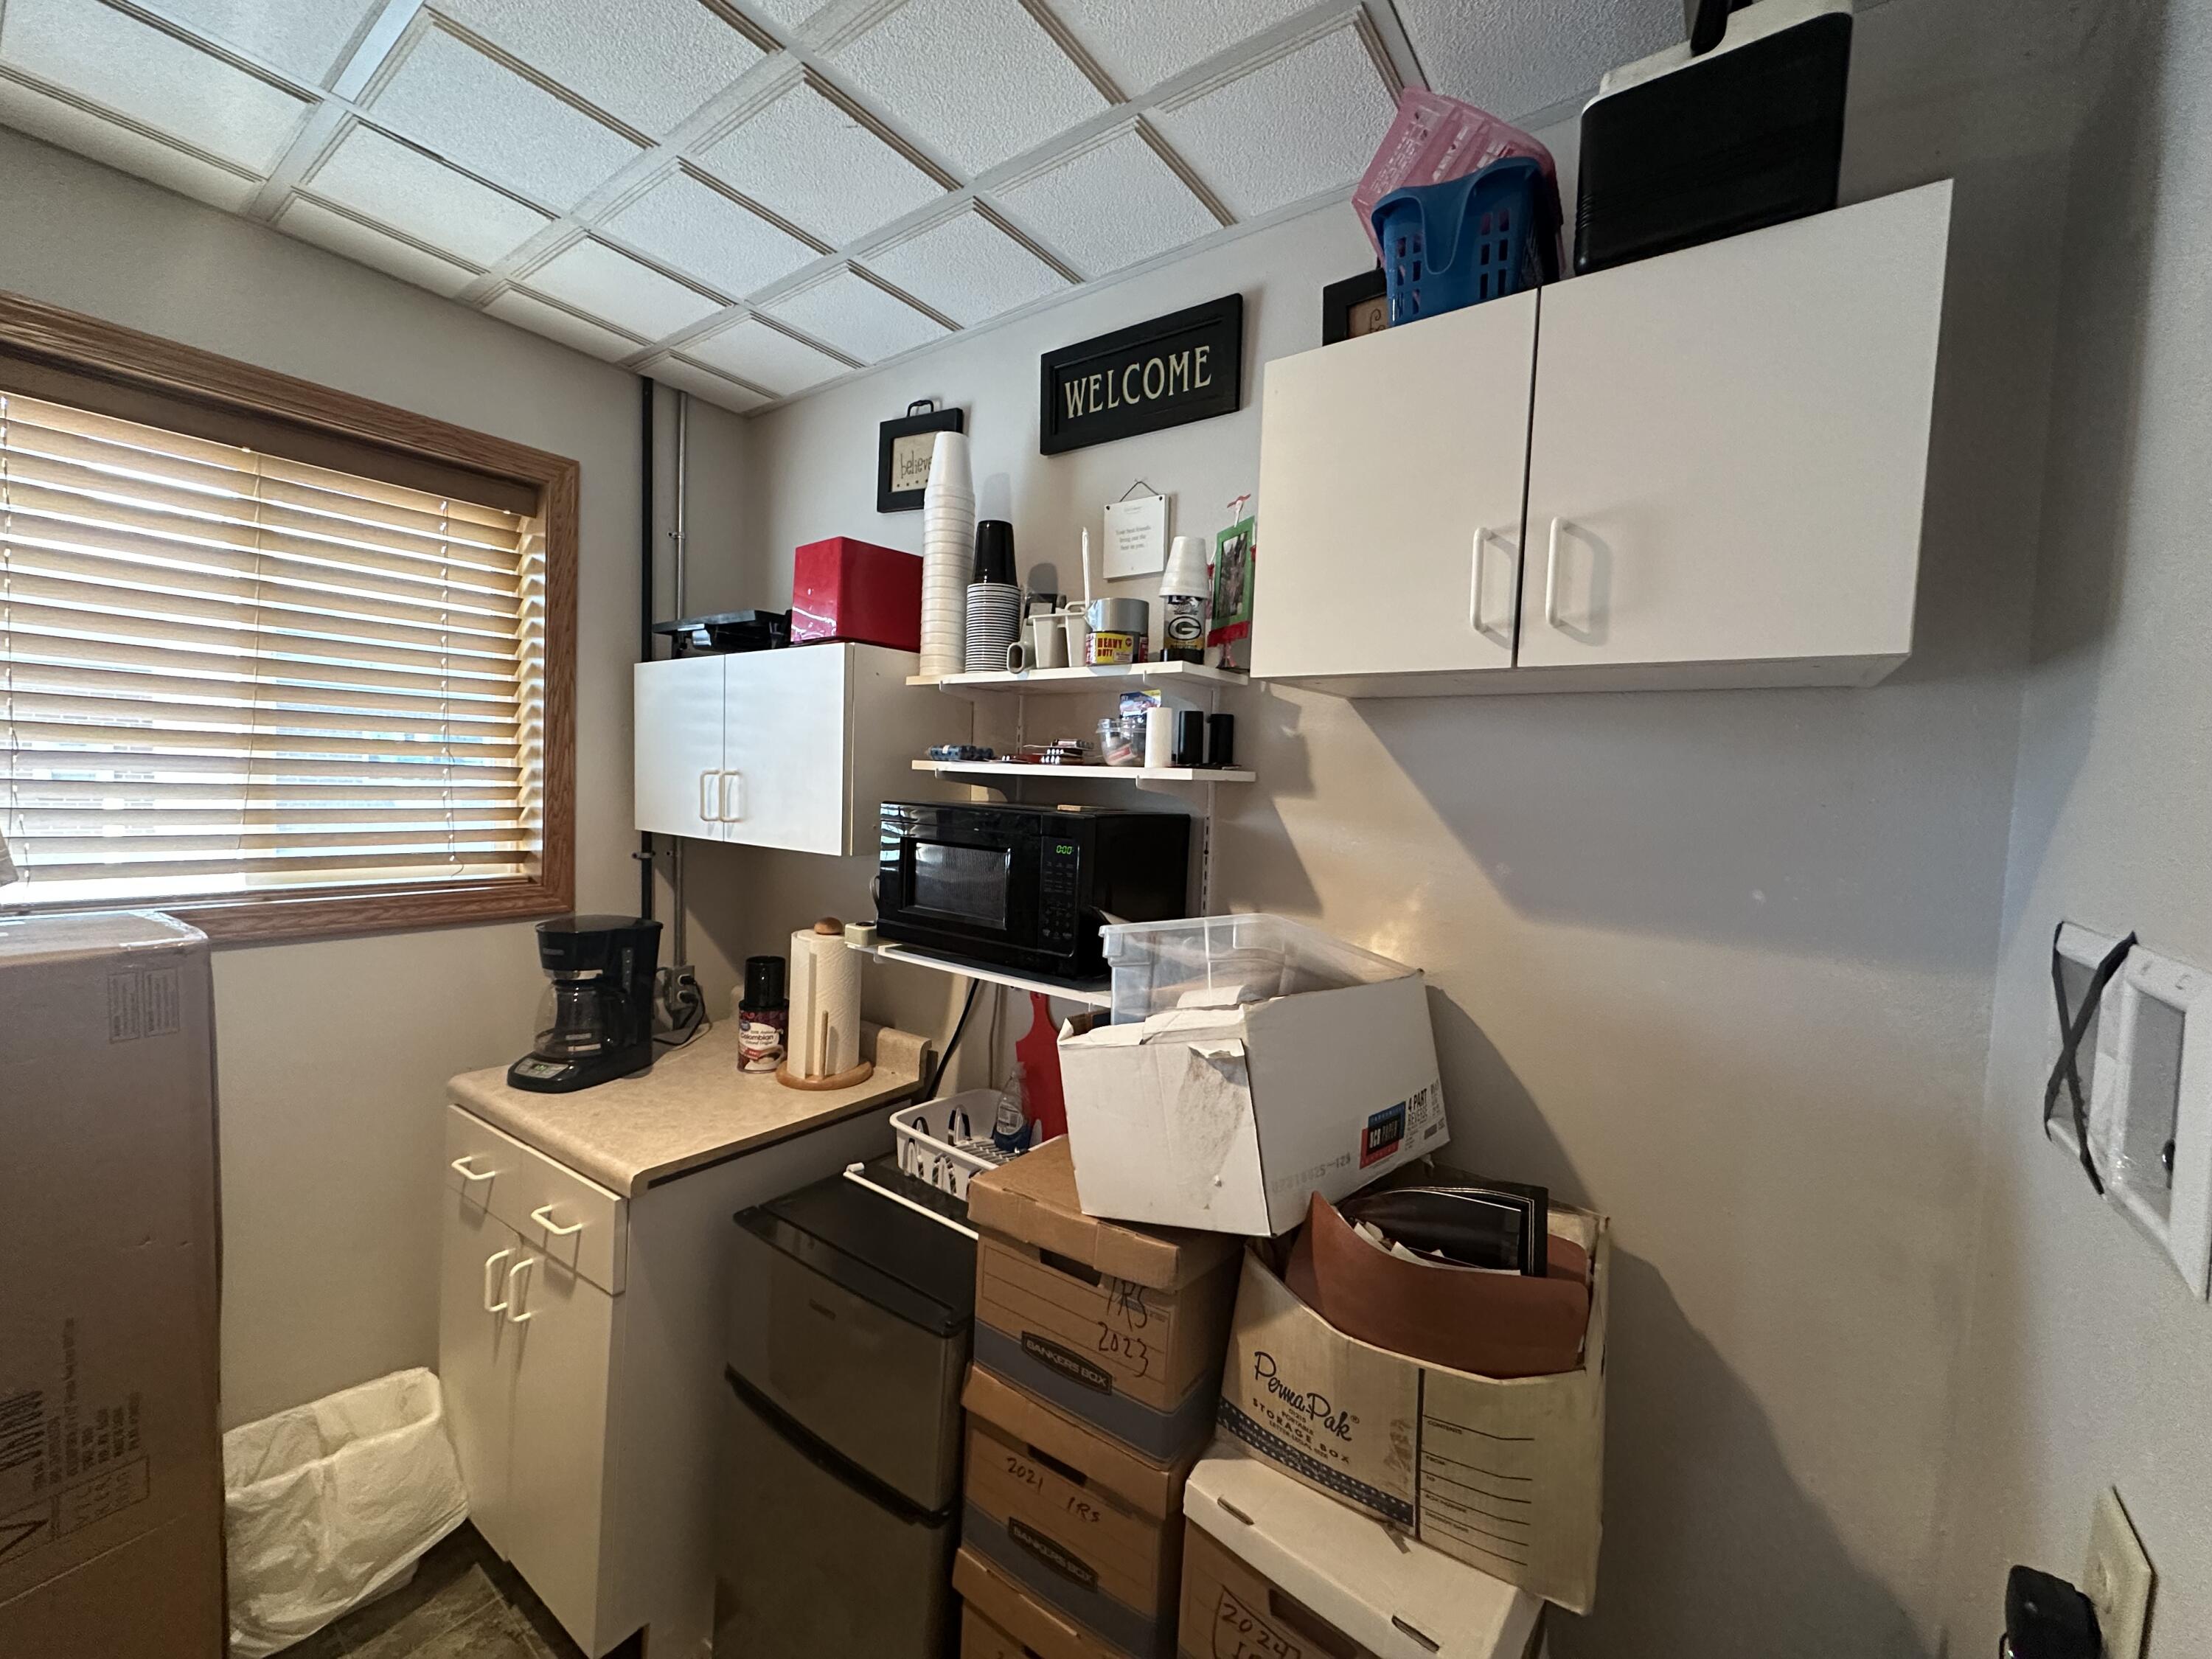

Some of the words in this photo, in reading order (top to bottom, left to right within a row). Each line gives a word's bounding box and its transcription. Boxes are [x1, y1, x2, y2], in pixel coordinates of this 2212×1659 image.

[1065, 345, 1211, 419] WELCOME
[1097, 637, 1122, 649] HEAVY
[1168, 616, 1202, 641] G
[1097, 649, 1113, 657] DUTY
[740, 1032, 774, 1040] Colombian
[1408, 1097, 1412, 1112] 4
[1413, 1088, 1427, 1110] PART
[1107, 1277, 1147, 1332] IRS
[1026, 1340, 1080, 1374] BANKERS
[1080, 1366, 1107, 1385] BOX
[1098, 1321, 1149, 1377] 2023
[1253, 1397, 1312, 1444] STORAGE
[1320, 1443, 1349, 1464] BOX
[1281, 1411, 1315, 1436] PORTABLE
[1427, 1419, 1463, 1435] CONTENTS
[1006, 1457, 1043, 1492] 2021
[1222, 1602, 1289, 1659] 2024
